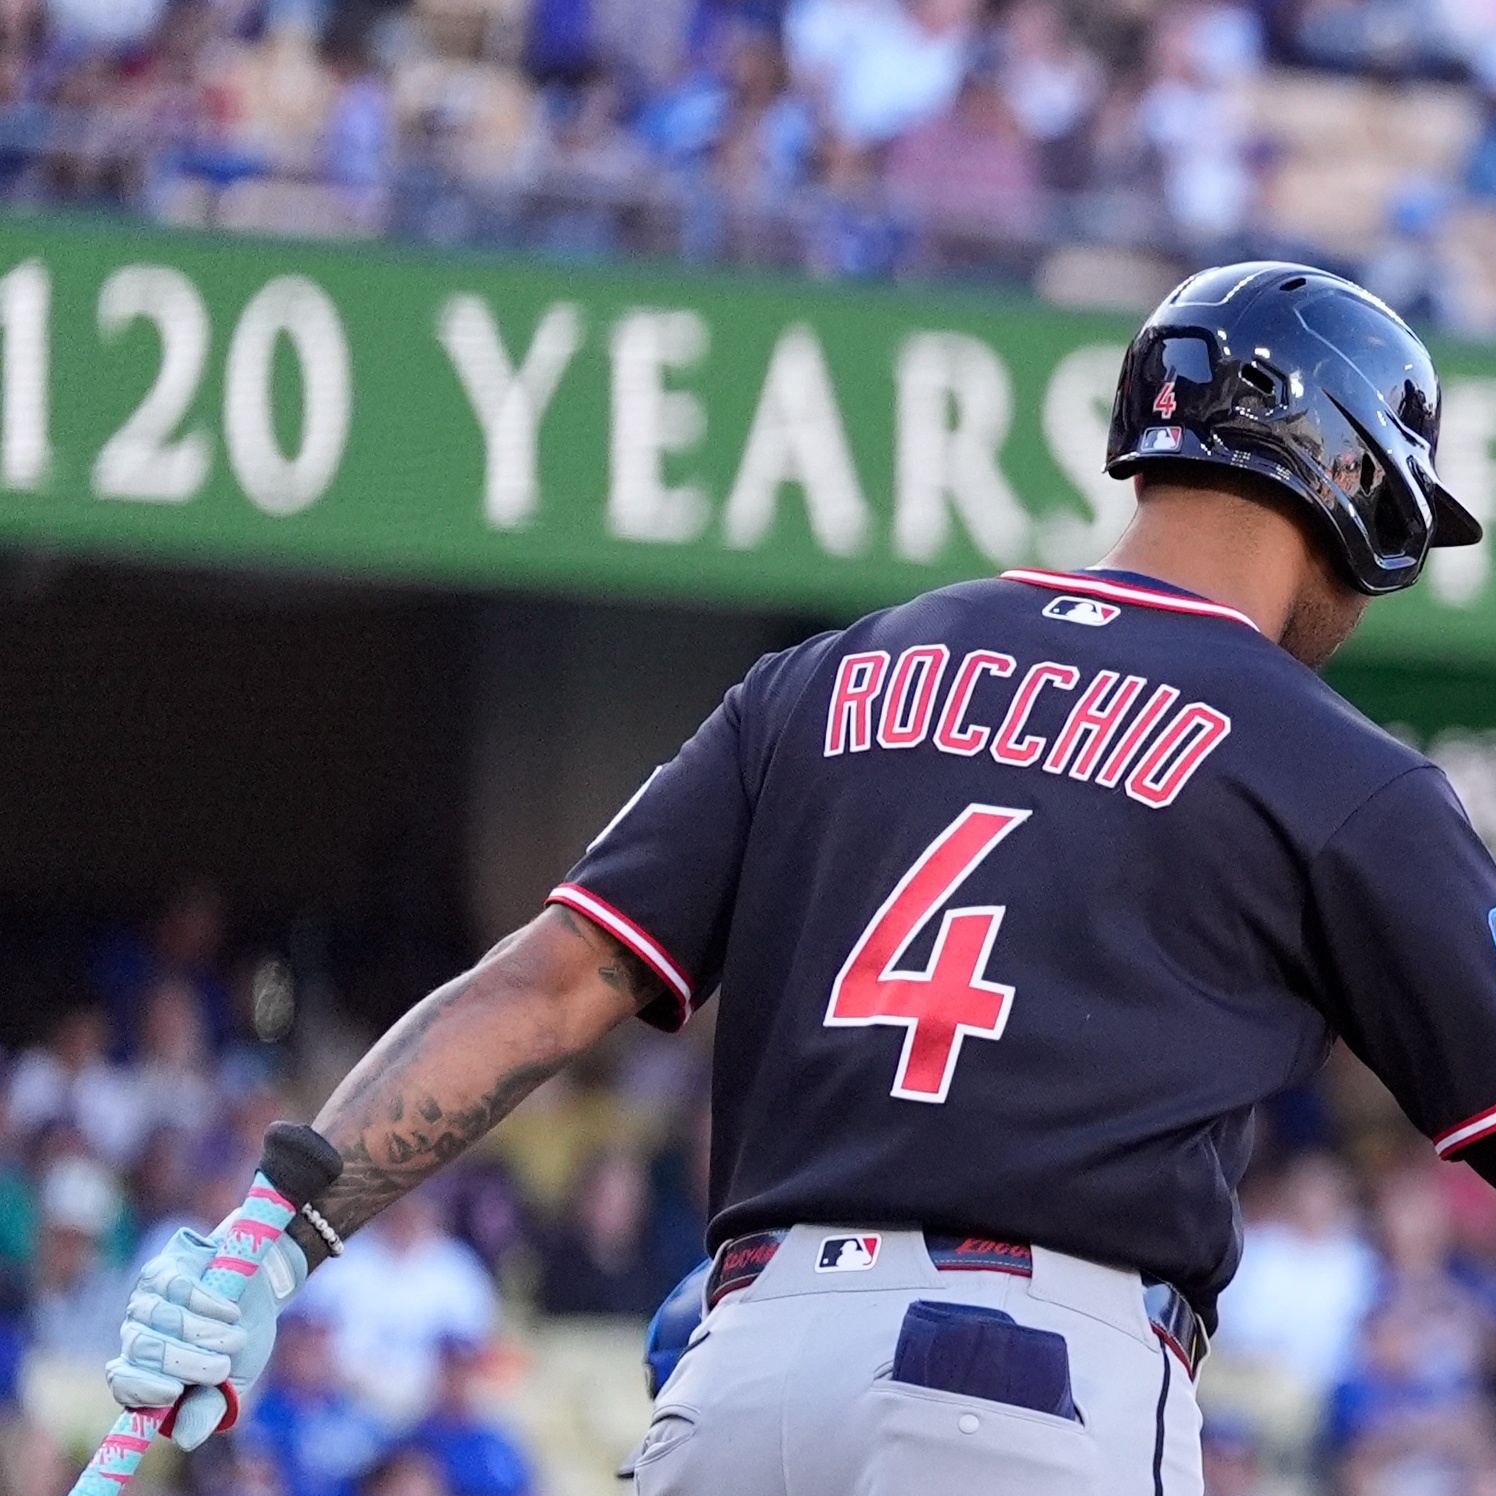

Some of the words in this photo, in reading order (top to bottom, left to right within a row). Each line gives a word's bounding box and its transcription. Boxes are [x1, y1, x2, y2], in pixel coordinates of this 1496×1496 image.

[0, 256, 352, 516] 120
[436, 290, 1133, 573] YEARS
[1153, 381, 1177, 420] 4
[823, 643, 1232, 809] ROCCHIO
[822, 802, 1034, 1104] 4
